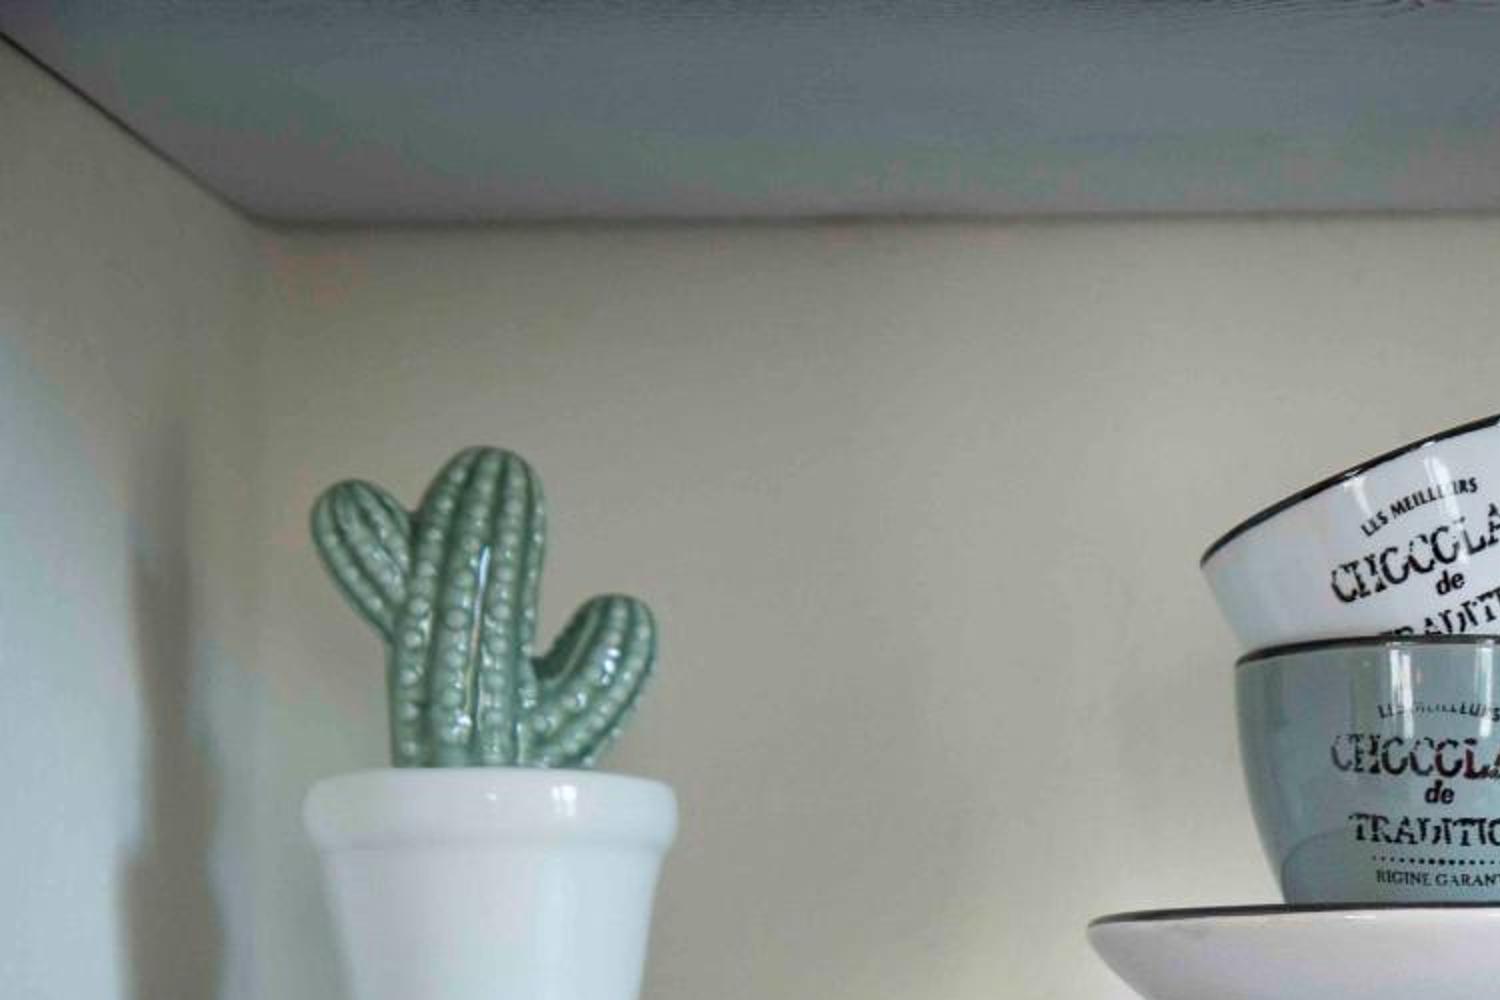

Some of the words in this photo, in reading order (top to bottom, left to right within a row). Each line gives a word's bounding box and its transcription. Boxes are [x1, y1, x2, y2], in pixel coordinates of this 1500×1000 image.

[1361, 509, 1389, 537] LES
[1435, 570, 1465, 595] de
[1424, 779, 1455, 804] de
